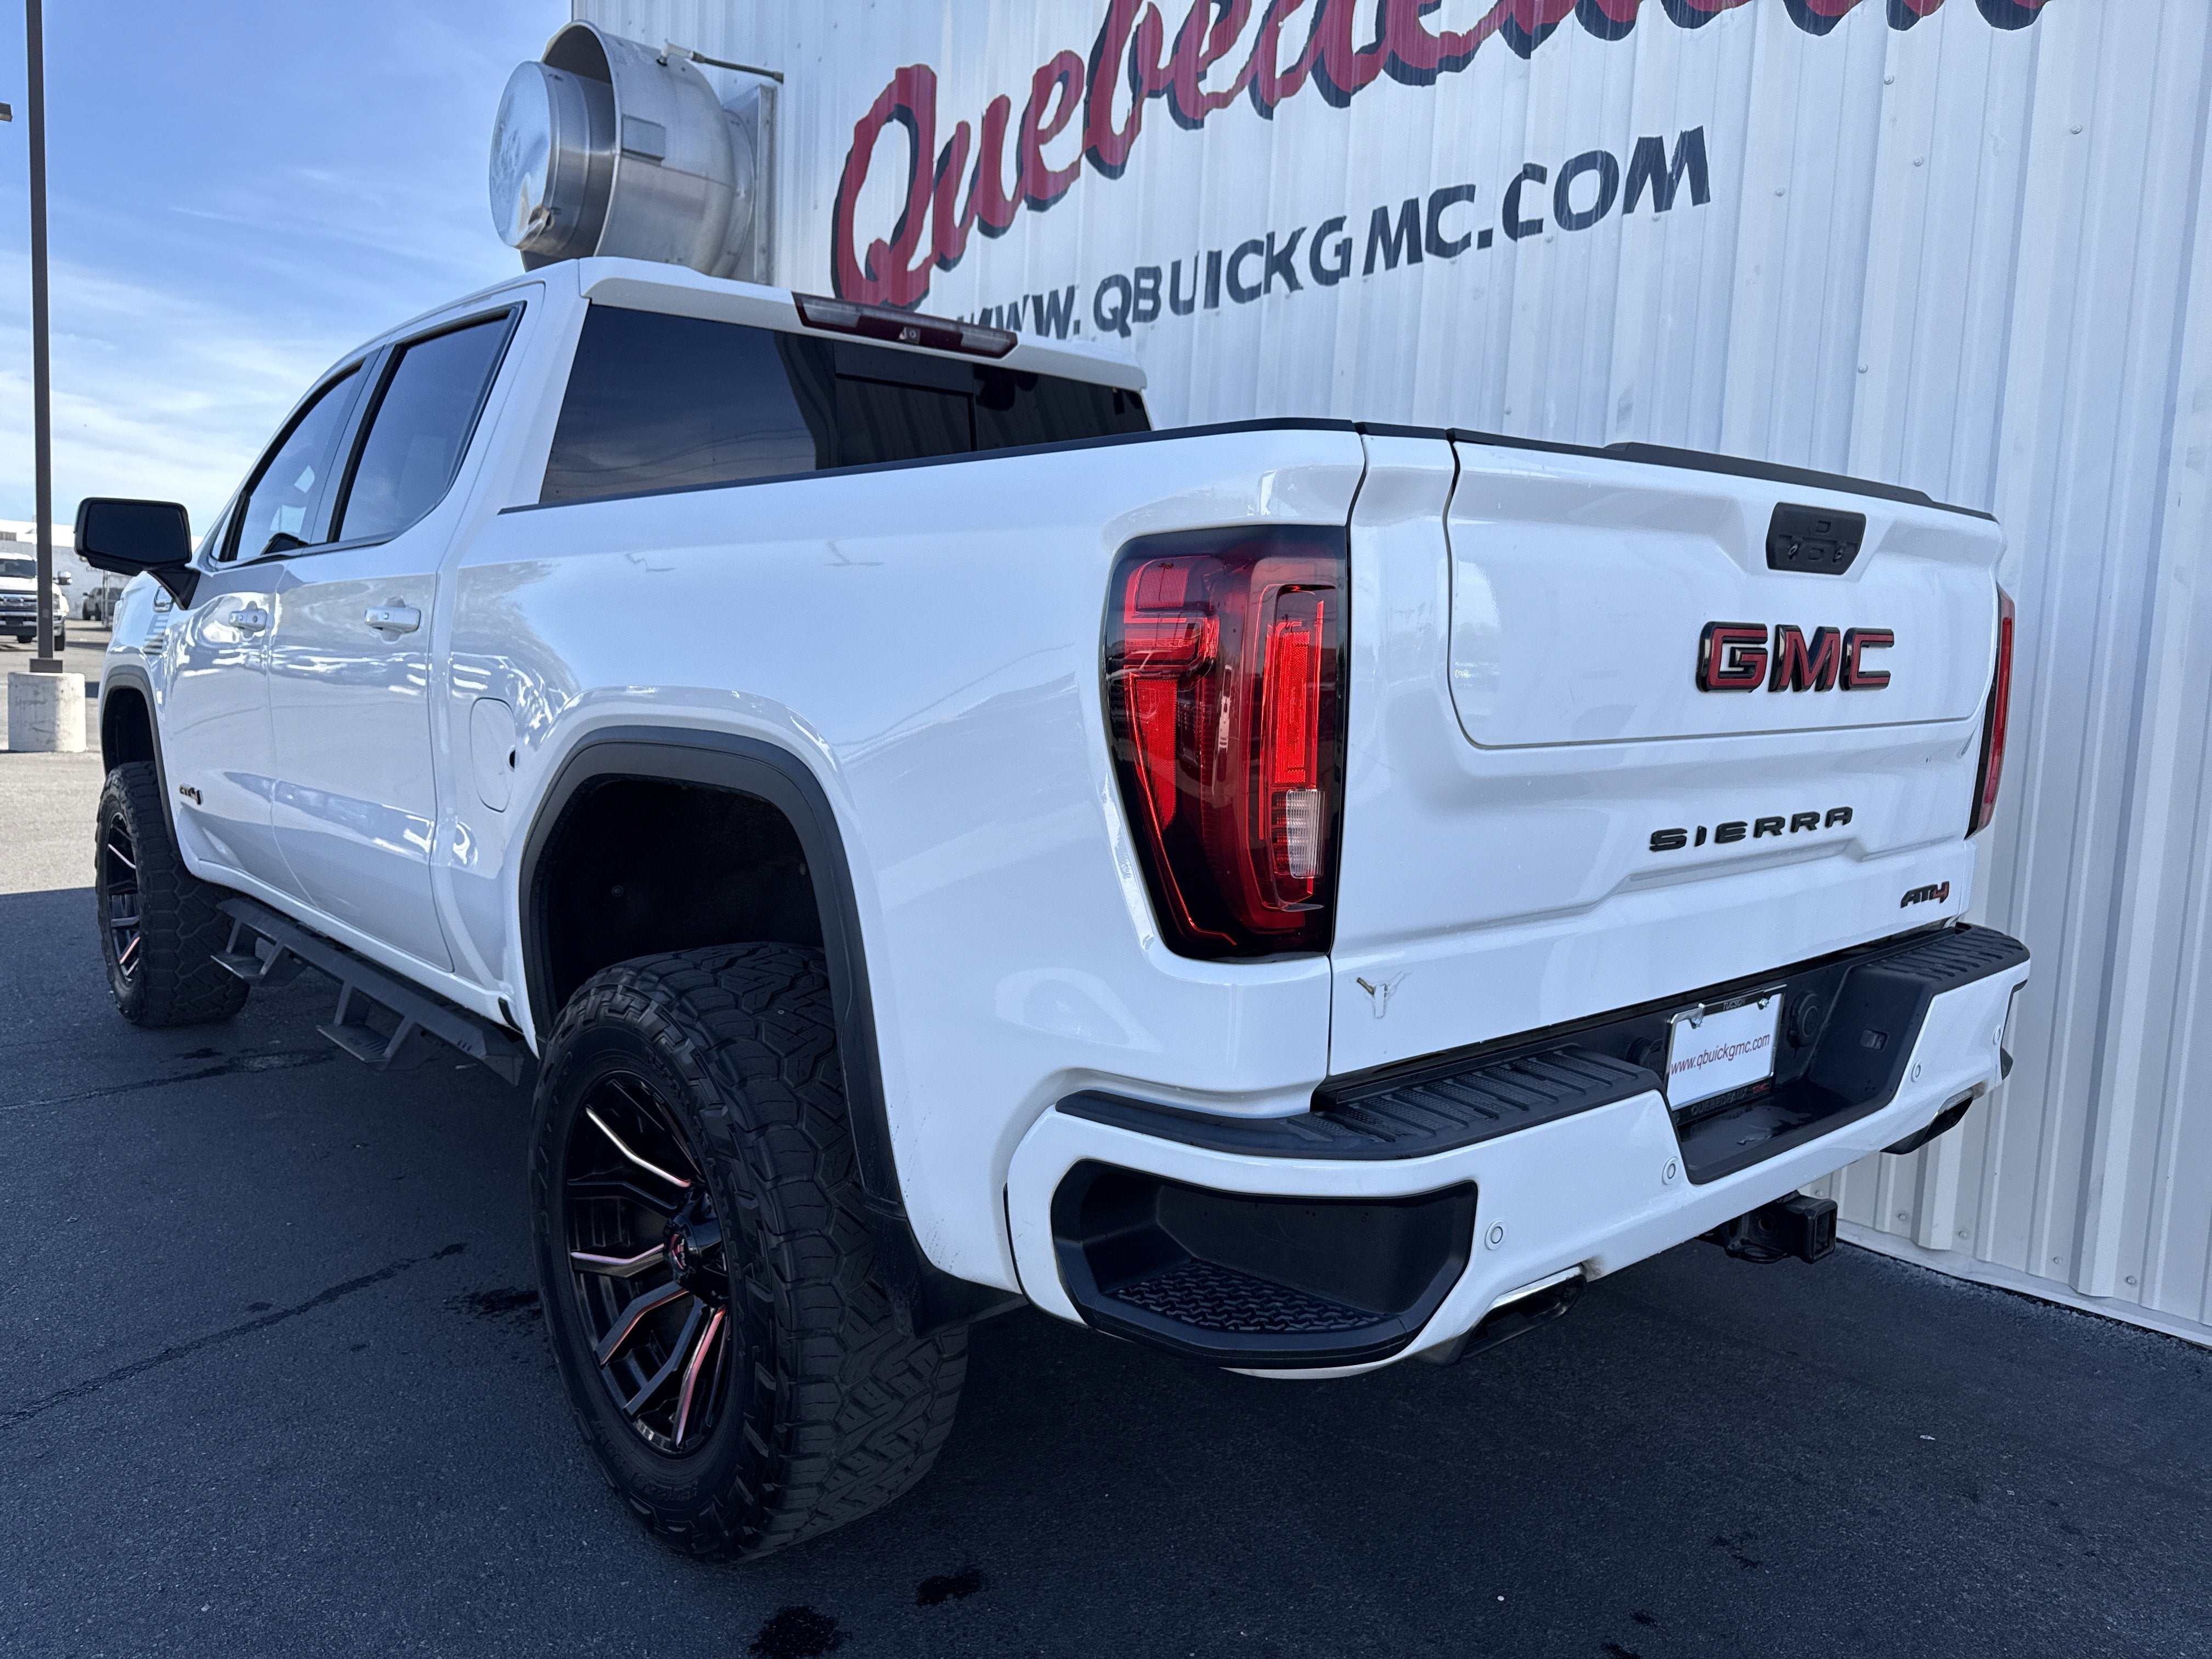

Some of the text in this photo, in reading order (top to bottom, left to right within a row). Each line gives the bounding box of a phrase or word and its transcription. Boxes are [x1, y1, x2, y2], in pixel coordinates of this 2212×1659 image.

[1695, 620, 1894, 693] GMC
[1649, 806, 1853, 851] SIERRA
[1900, 881, 1950, 909] AT4
[1723, 997, 1747, 1011] TUCSON
[1671, 1034, 1770, 1075] www.qbuickgmc.com
